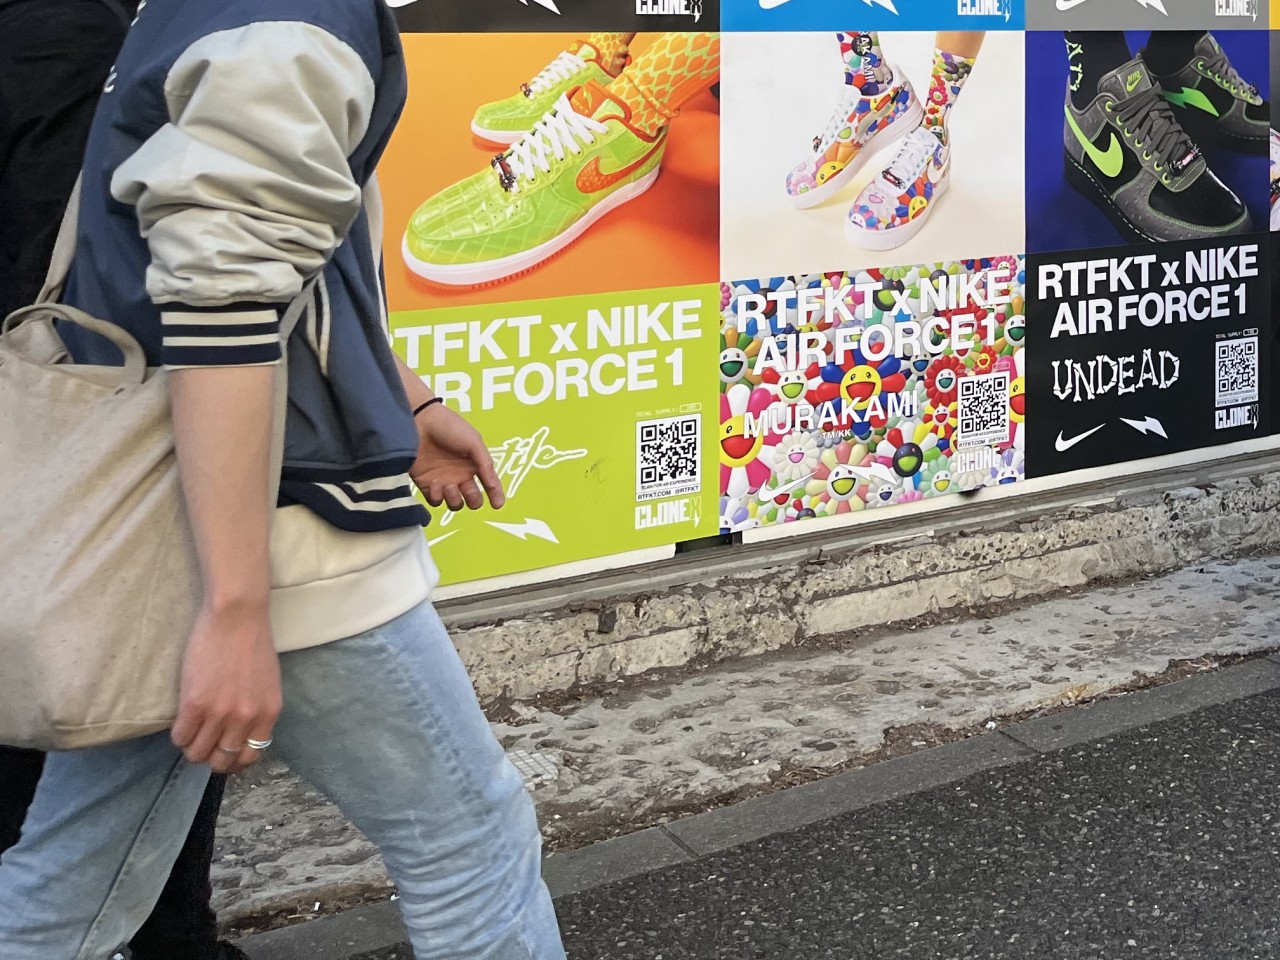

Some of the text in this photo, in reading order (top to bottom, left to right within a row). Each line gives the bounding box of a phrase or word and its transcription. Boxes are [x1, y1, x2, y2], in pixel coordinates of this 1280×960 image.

[1038, 254, 1157, 300] RTFKT
[1160, 261, 1181, 287] x
[1185, 244, 1259, 284] NIKE
[737, 270, 1011, 333] RTFKT x NIKE
[1050, 283, 1246, 338] AIR FORCE 1
[393, 299, 702, 369] TFKT x NIKE
[752, 312, 996, 376] AIR FORCE 1
[482, 349, 658, 410] FORCE
[664, 348, 684, 387] 1
[1051, 348, 1180, 402] UNDEAD
[743, 390, 919, 439] MURAKAMI
[637, 490, 671, 500] RTFKT.COM
